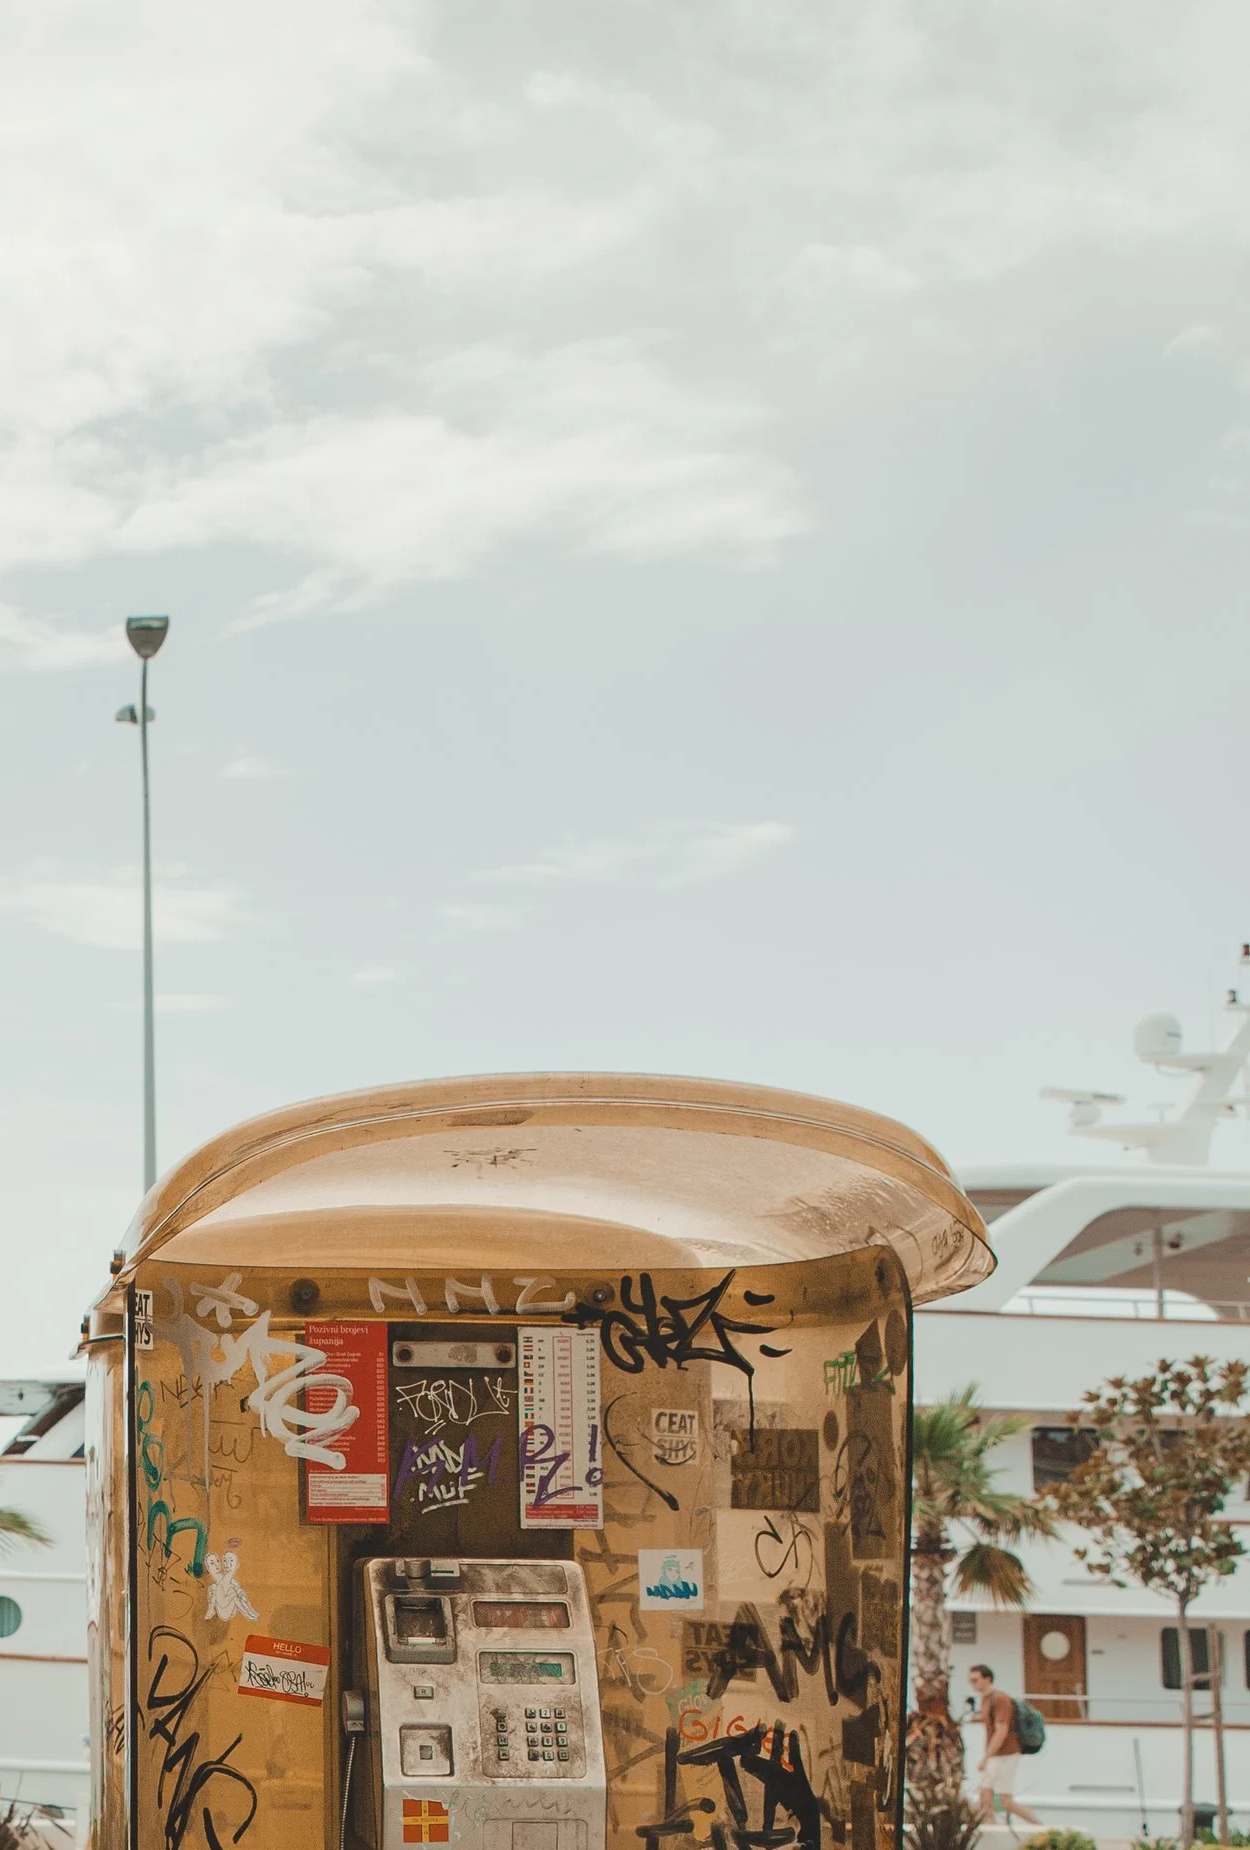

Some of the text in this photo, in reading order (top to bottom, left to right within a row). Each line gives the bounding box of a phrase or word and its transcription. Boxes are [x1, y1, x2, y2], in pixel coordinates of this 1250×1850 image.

[308, 1325, 369, 1335] Pozivni brojevi
[308, 1337, 344, 1346] županija
[273, 1642, 302, 1654] HELLO
